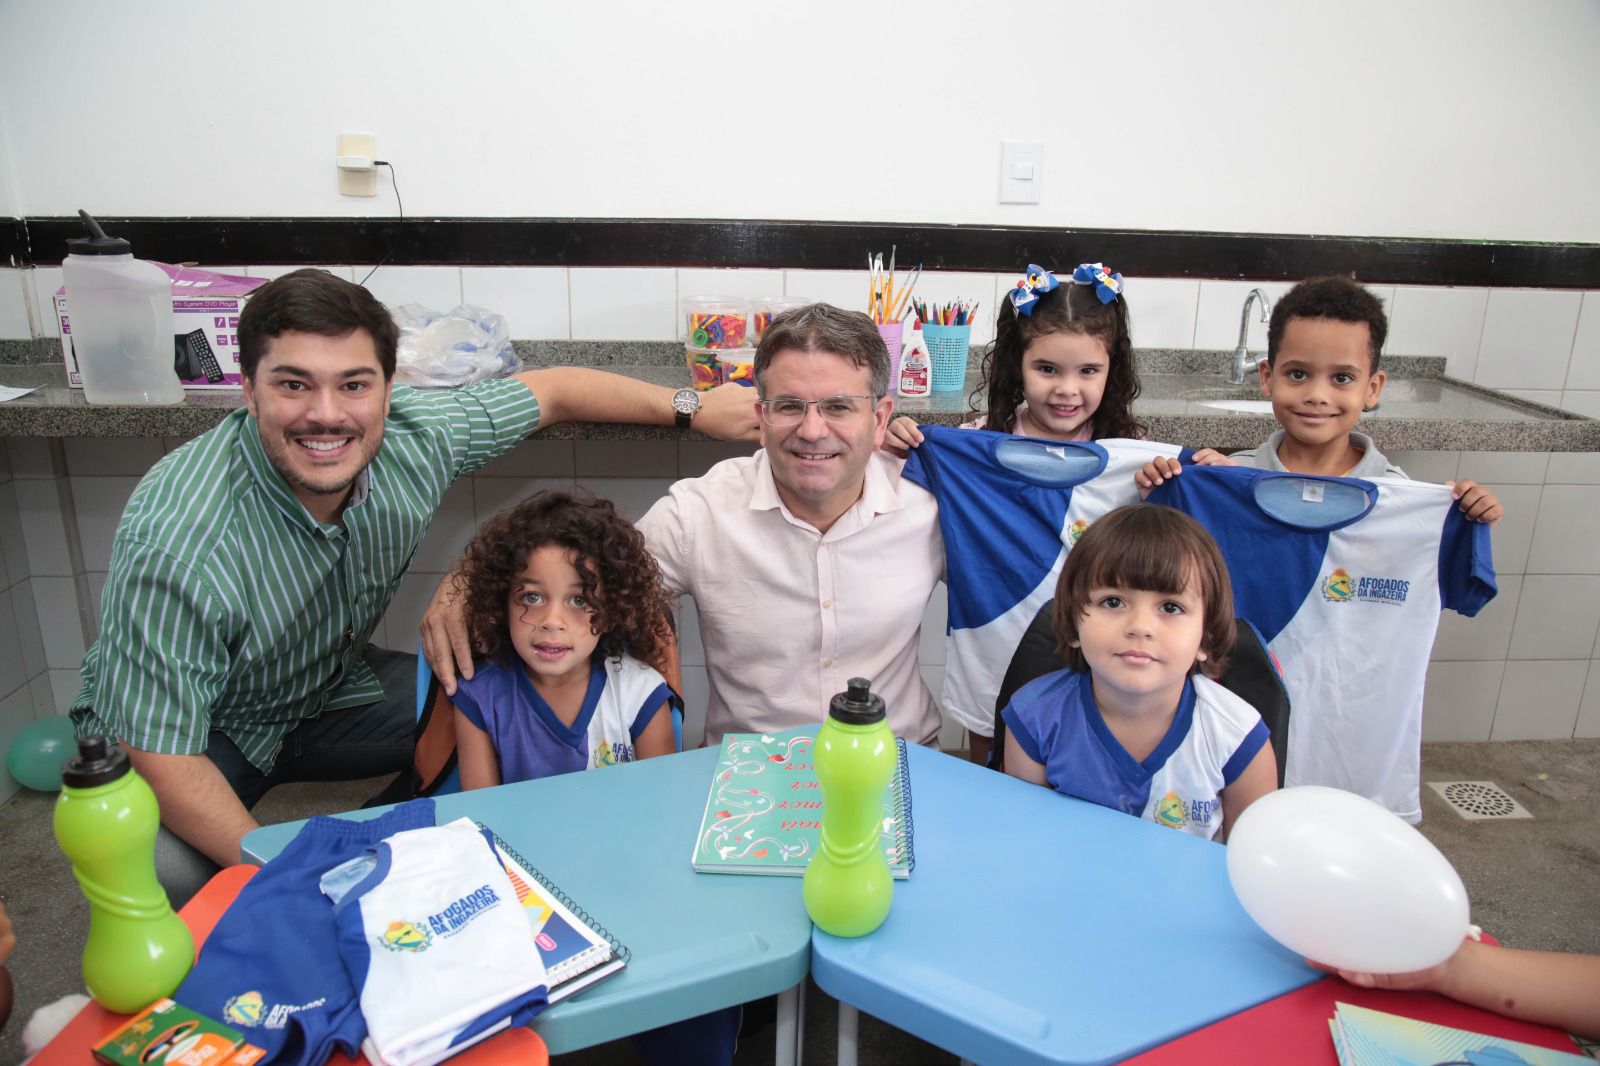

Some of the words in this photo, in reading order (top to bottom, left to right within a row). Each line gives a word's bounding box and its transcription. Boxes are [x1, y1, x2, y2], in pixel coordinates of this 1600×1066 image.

[1360, 577, 1409, 593] AFOGADOS
[1358, 588, 1367, 597] DA
[1369, 589, 1407, 602] INGAZEIRA
[1192, 811, 1202, 822] DA
[428, 884, 495, 927] AFOGADOS
[432, 922, 450, 935] DA
[448, 893, 500, 930] INGAZEIRA
